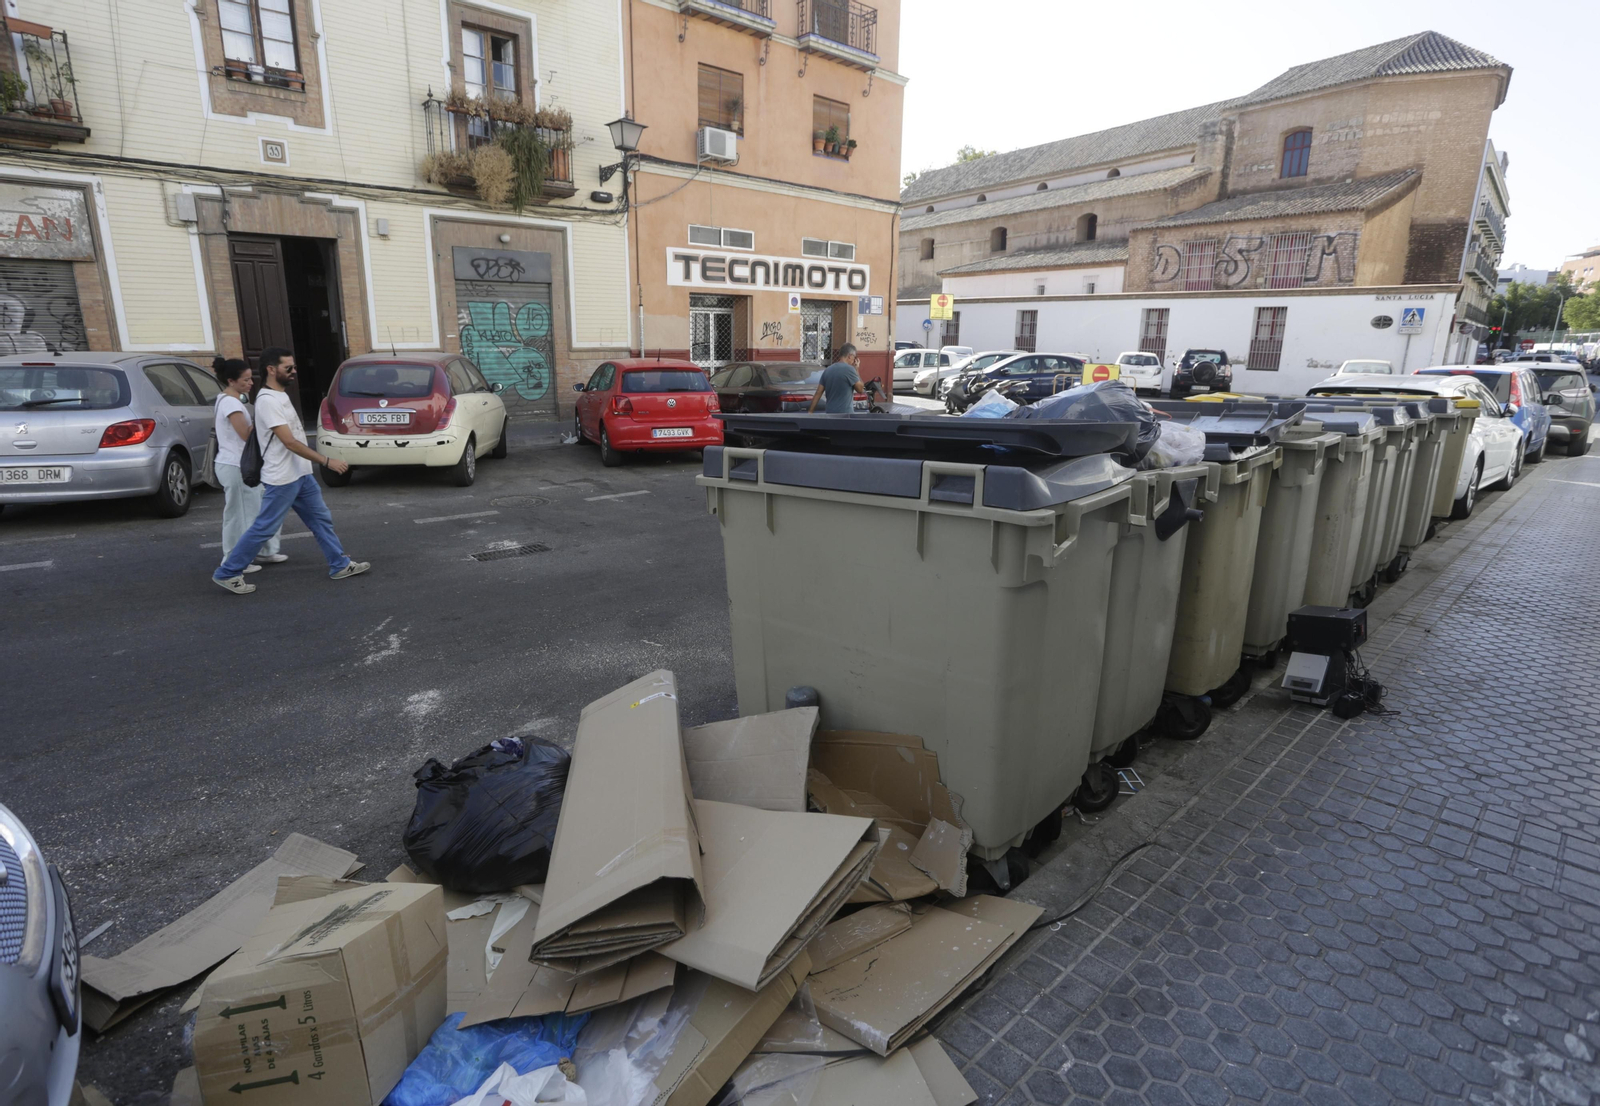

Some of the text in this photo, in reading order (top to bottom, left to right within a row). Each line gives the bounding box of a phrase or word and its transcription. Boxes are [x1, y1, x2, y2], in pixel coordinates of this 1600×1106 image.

[674, 252, 867, 292] TECNIMOTO
[366, 414, 407, 423] 0525 FBT
[658, 428, 690, 437] 7493 GVK
[0, 469, 61, 481] 1368 DRM
[303, 989, 314, 1012] Litros
[297, 1015, 316, 1025] 5
[261, 1018, 272, 1048] CAJAS
[238, 1023, 253, 1074] NO APILAR
[252, 1035, 262, 1057] MAS
[308, 1033, 324, 1068] Garrafas
[267, 1057, 276, 1070] DE
[307, 1071, 326, 1080] 4
